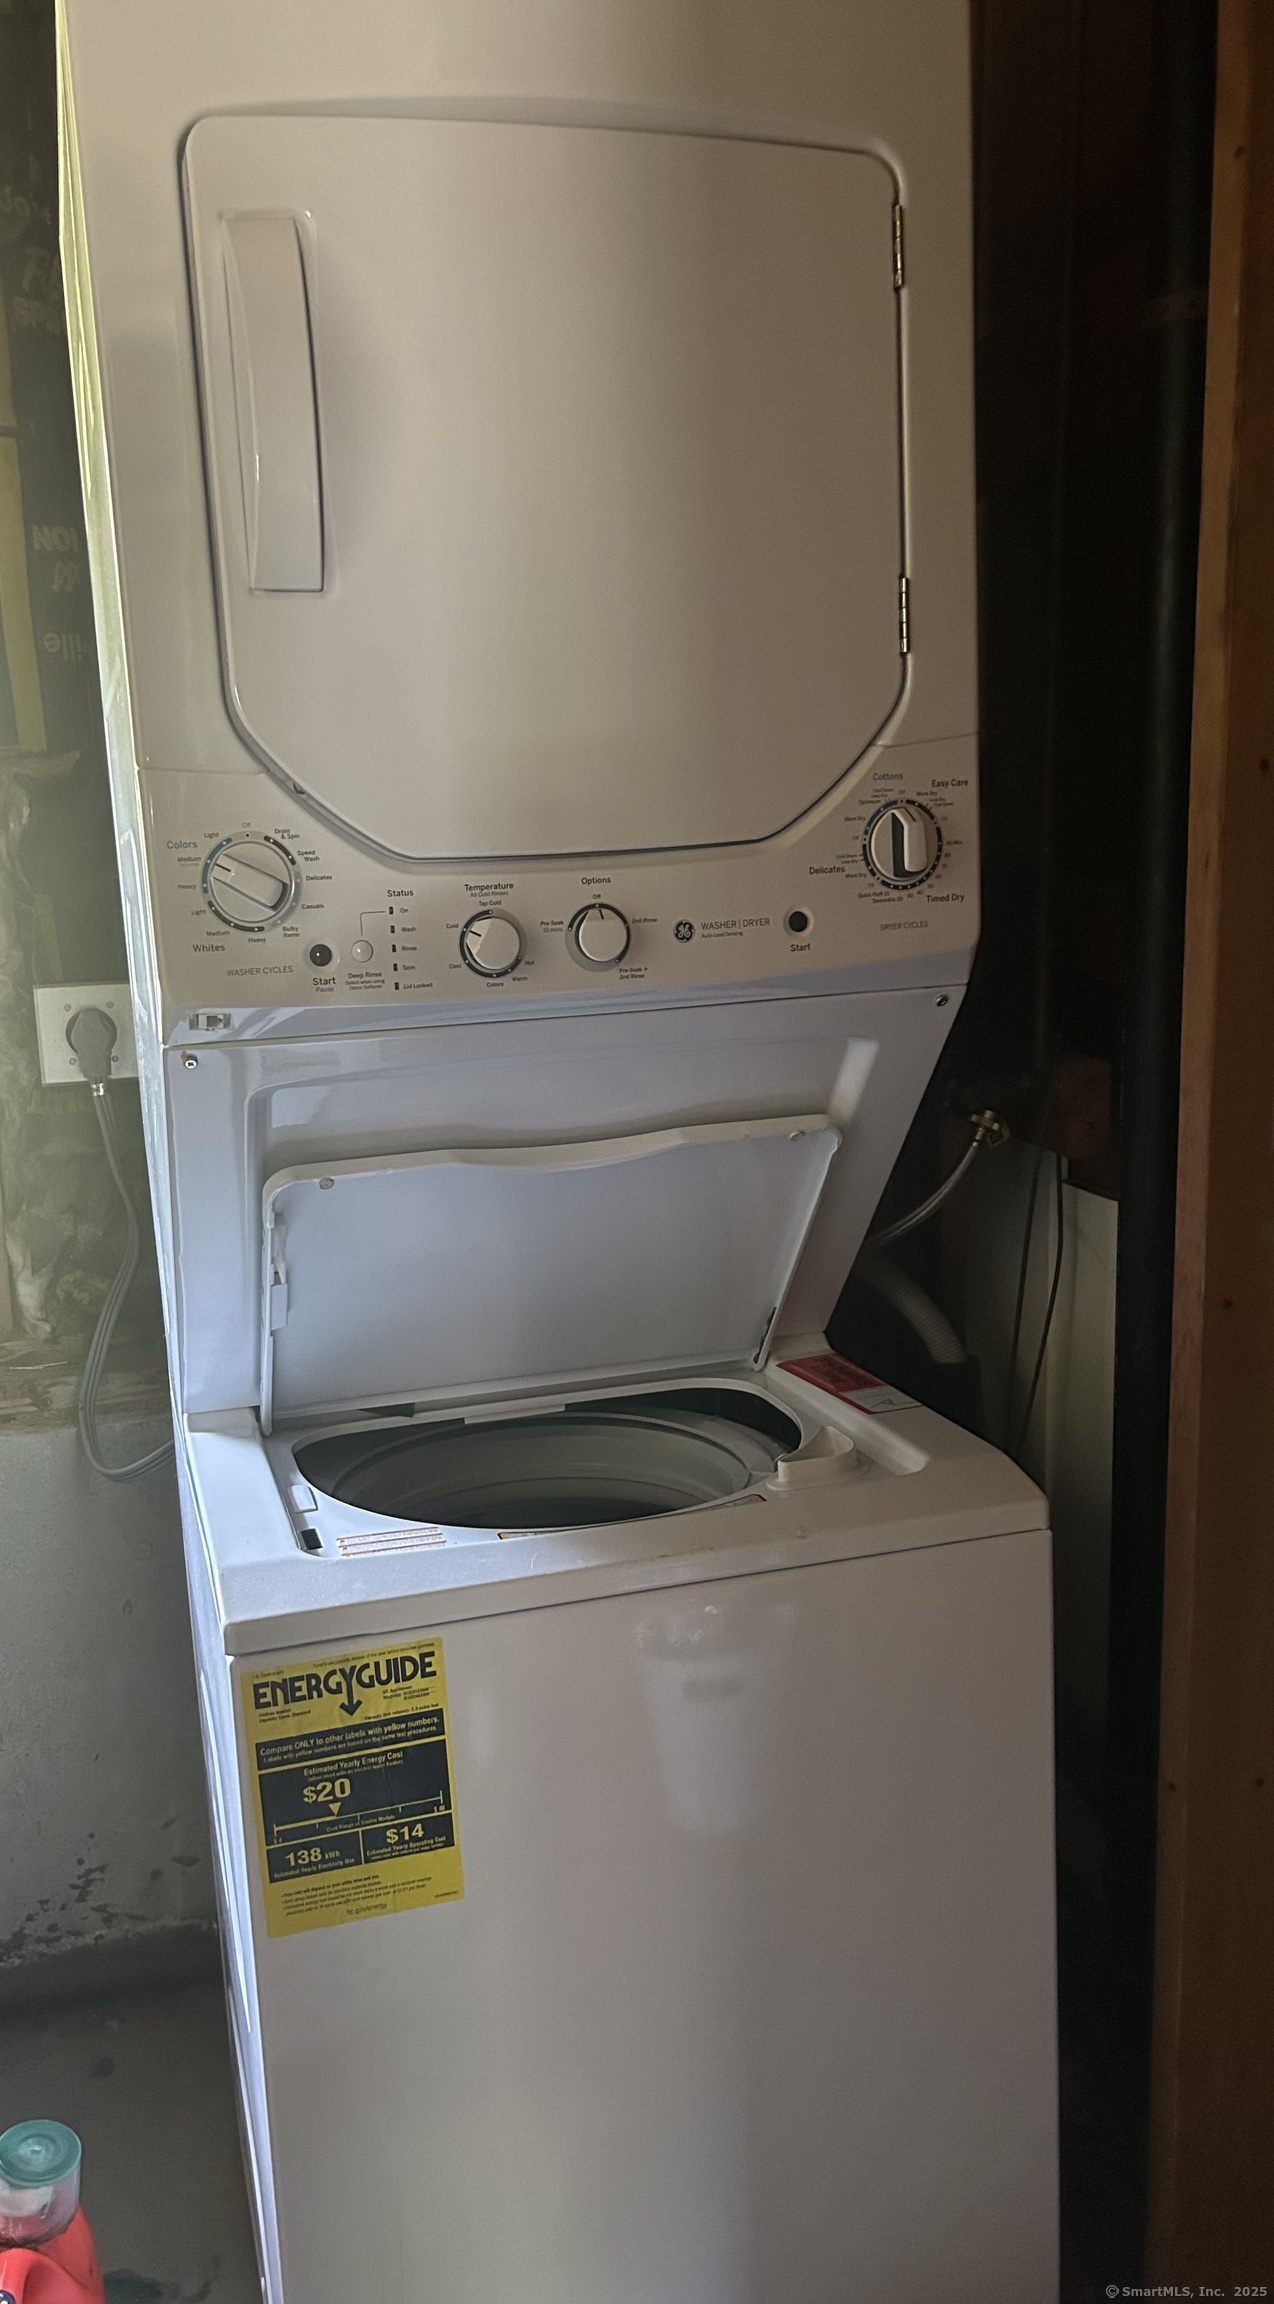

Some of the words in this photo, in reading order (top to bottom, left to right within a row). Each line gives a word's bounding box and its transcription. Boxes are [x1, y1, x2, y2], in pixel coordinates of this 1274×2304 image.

[872, 772, 903, 781] Cottons
[932, 779, 950, 788] Easy
[951, 778, 968, 787] Care
[166, 840, 198, 850] Colors
[809, 864, 846, 875] Delicates
[581, 876, 612, 886] Options
[387, 888, 414, 898] Status
[464, 882, 514, 894] Temperature
[926, 894, 950, 903] Timed
[952, 893, 965, 902] Dry
[701, 920, 737, 931] WASHER
[742, 917, 770, 928] DRYER
[880, 922, 904, 932] DRYER
[904, 920, 928, 930] CYCLES
[192, 944, 226, 952] Whites
[790, 943, 811, 952] Start
[226, 968, 262, 977] WASHER
[262, 965, 294, 975] CYCLES
[312, 976, 336, 986] Start
[253, 1651, 437, 1711] ENERGYGUIDE
[292, 1709, 311, 1718] Standard
[260, 1744, 294, 1756] Compare
[294, 1738, 315, 1749] ONLY
[325, 1734, 344, 1744] other
[345, 1729, 366, 1740] labels
[368, 1726, 382, 1736] with
[384, 1722, 406, 1734] yellow
[408, 1716, 440, 1727] numbers.
[264, 1754, 282, 1762] Labels
[295, 1750, 313, 1758] yellow
[314, 1744, 337, 1754] numbers
[348, 1738, 364, 1747] based
[304, 1763, 338, 1776] Estimated
[340, 1758, 360, 1769] Yearly
[362, 1754, 386, 1766] Energy
[387, 1750, 404, 1760] Cost
[302, 1778, 351, 1804] $20
[338, 1822, 354, 1830] Range
[386, 1823, 424, 1844] $14
[366, 1848, 392, 1857] Estimated
[392, 1842, 408, 1851] Yearly
[409, 1838, 434, 1848] Operating
[286, 1847, 322, 1867] 138
[324, 1850, 340, 1860] kWh
[274, 1870, 300, 1878] Estimated
[318, 1860, 344, 1870] Electricity
